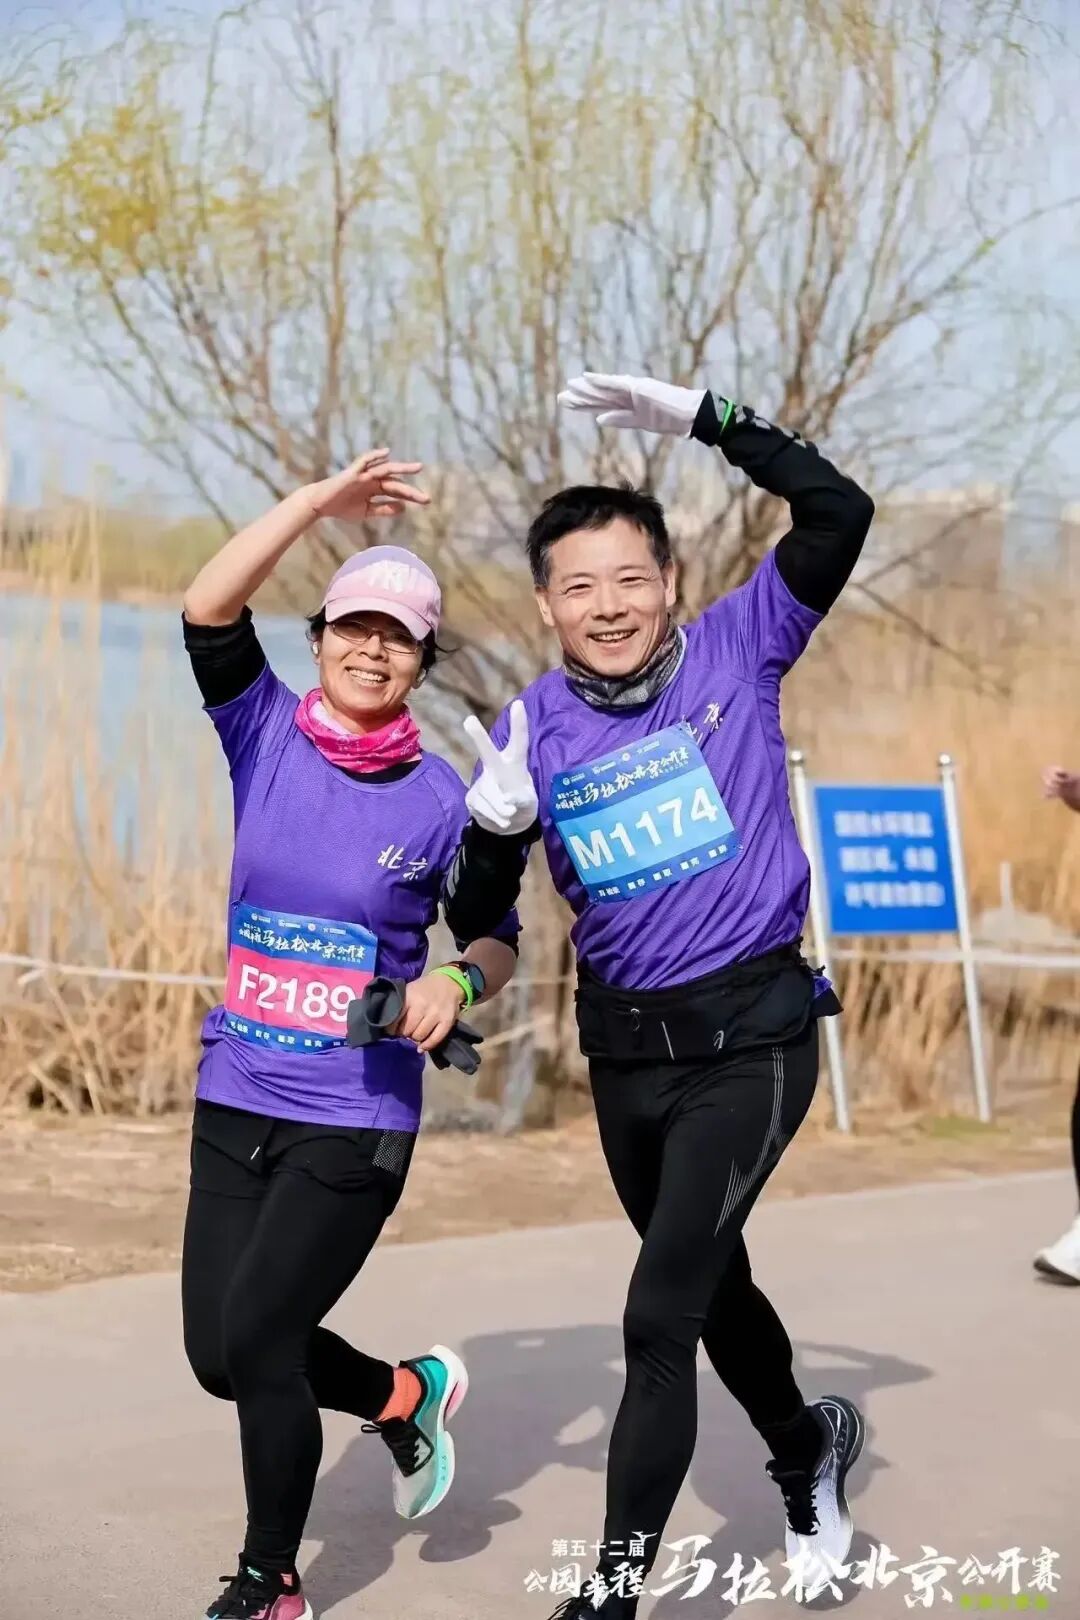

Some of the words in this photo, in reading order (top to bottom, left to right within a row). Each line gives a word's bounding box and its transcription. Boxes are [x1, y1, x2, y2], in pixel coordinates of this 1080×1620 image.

[568, 786, 719, 870] M1174
[378, 844, 428, 880] 北京
[237, 963, 357, 1022] F2189
